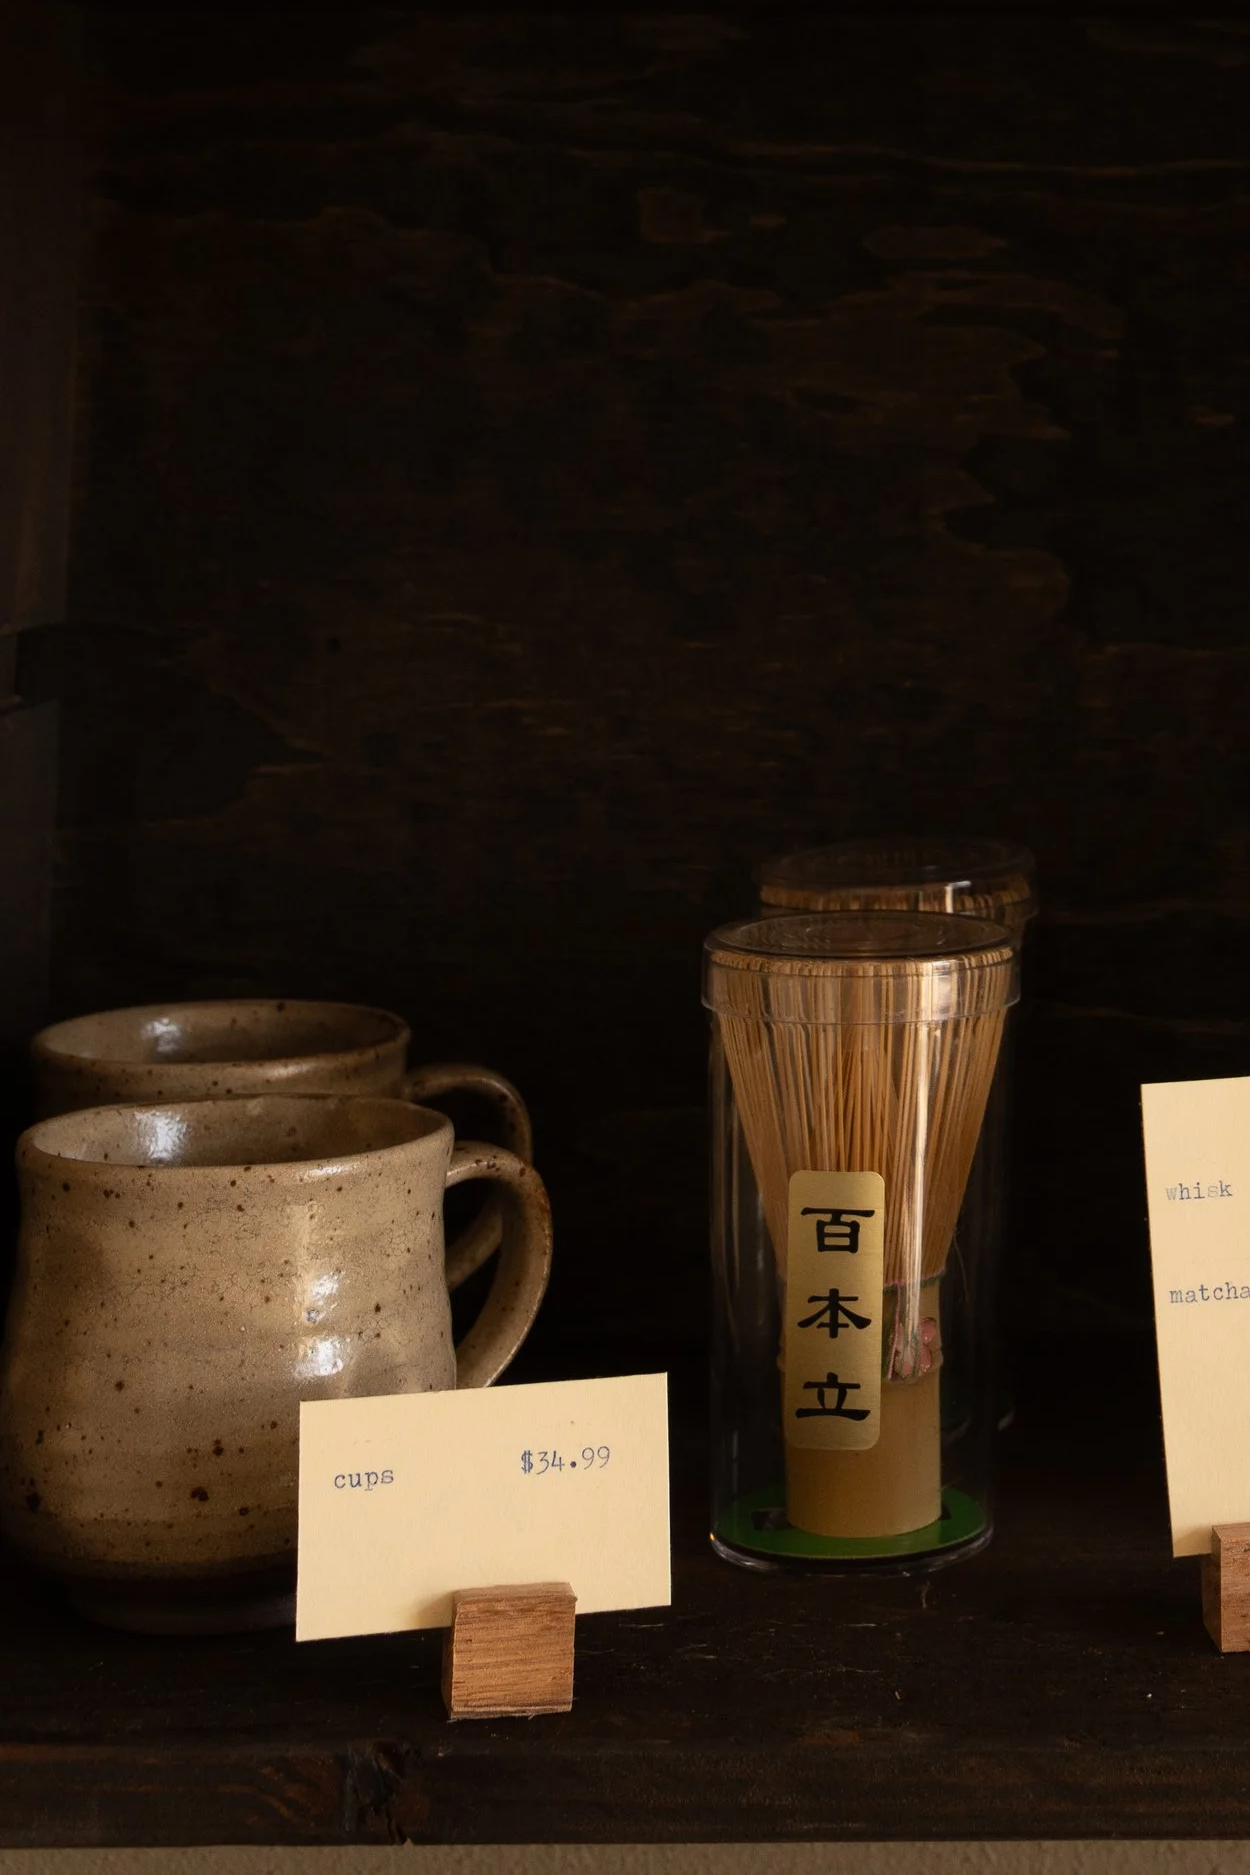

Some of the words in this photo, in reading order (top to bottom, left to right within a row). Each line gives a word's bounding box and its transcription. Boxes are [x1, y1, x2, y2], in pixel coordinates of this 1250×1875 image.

[1165, 1180, 1233, 1201] whisk
[794, 1206, 876, 1423] 百本立
[333, 1469, 395, 1492] cups
[520, 1445, 611, 1476] $34.99
